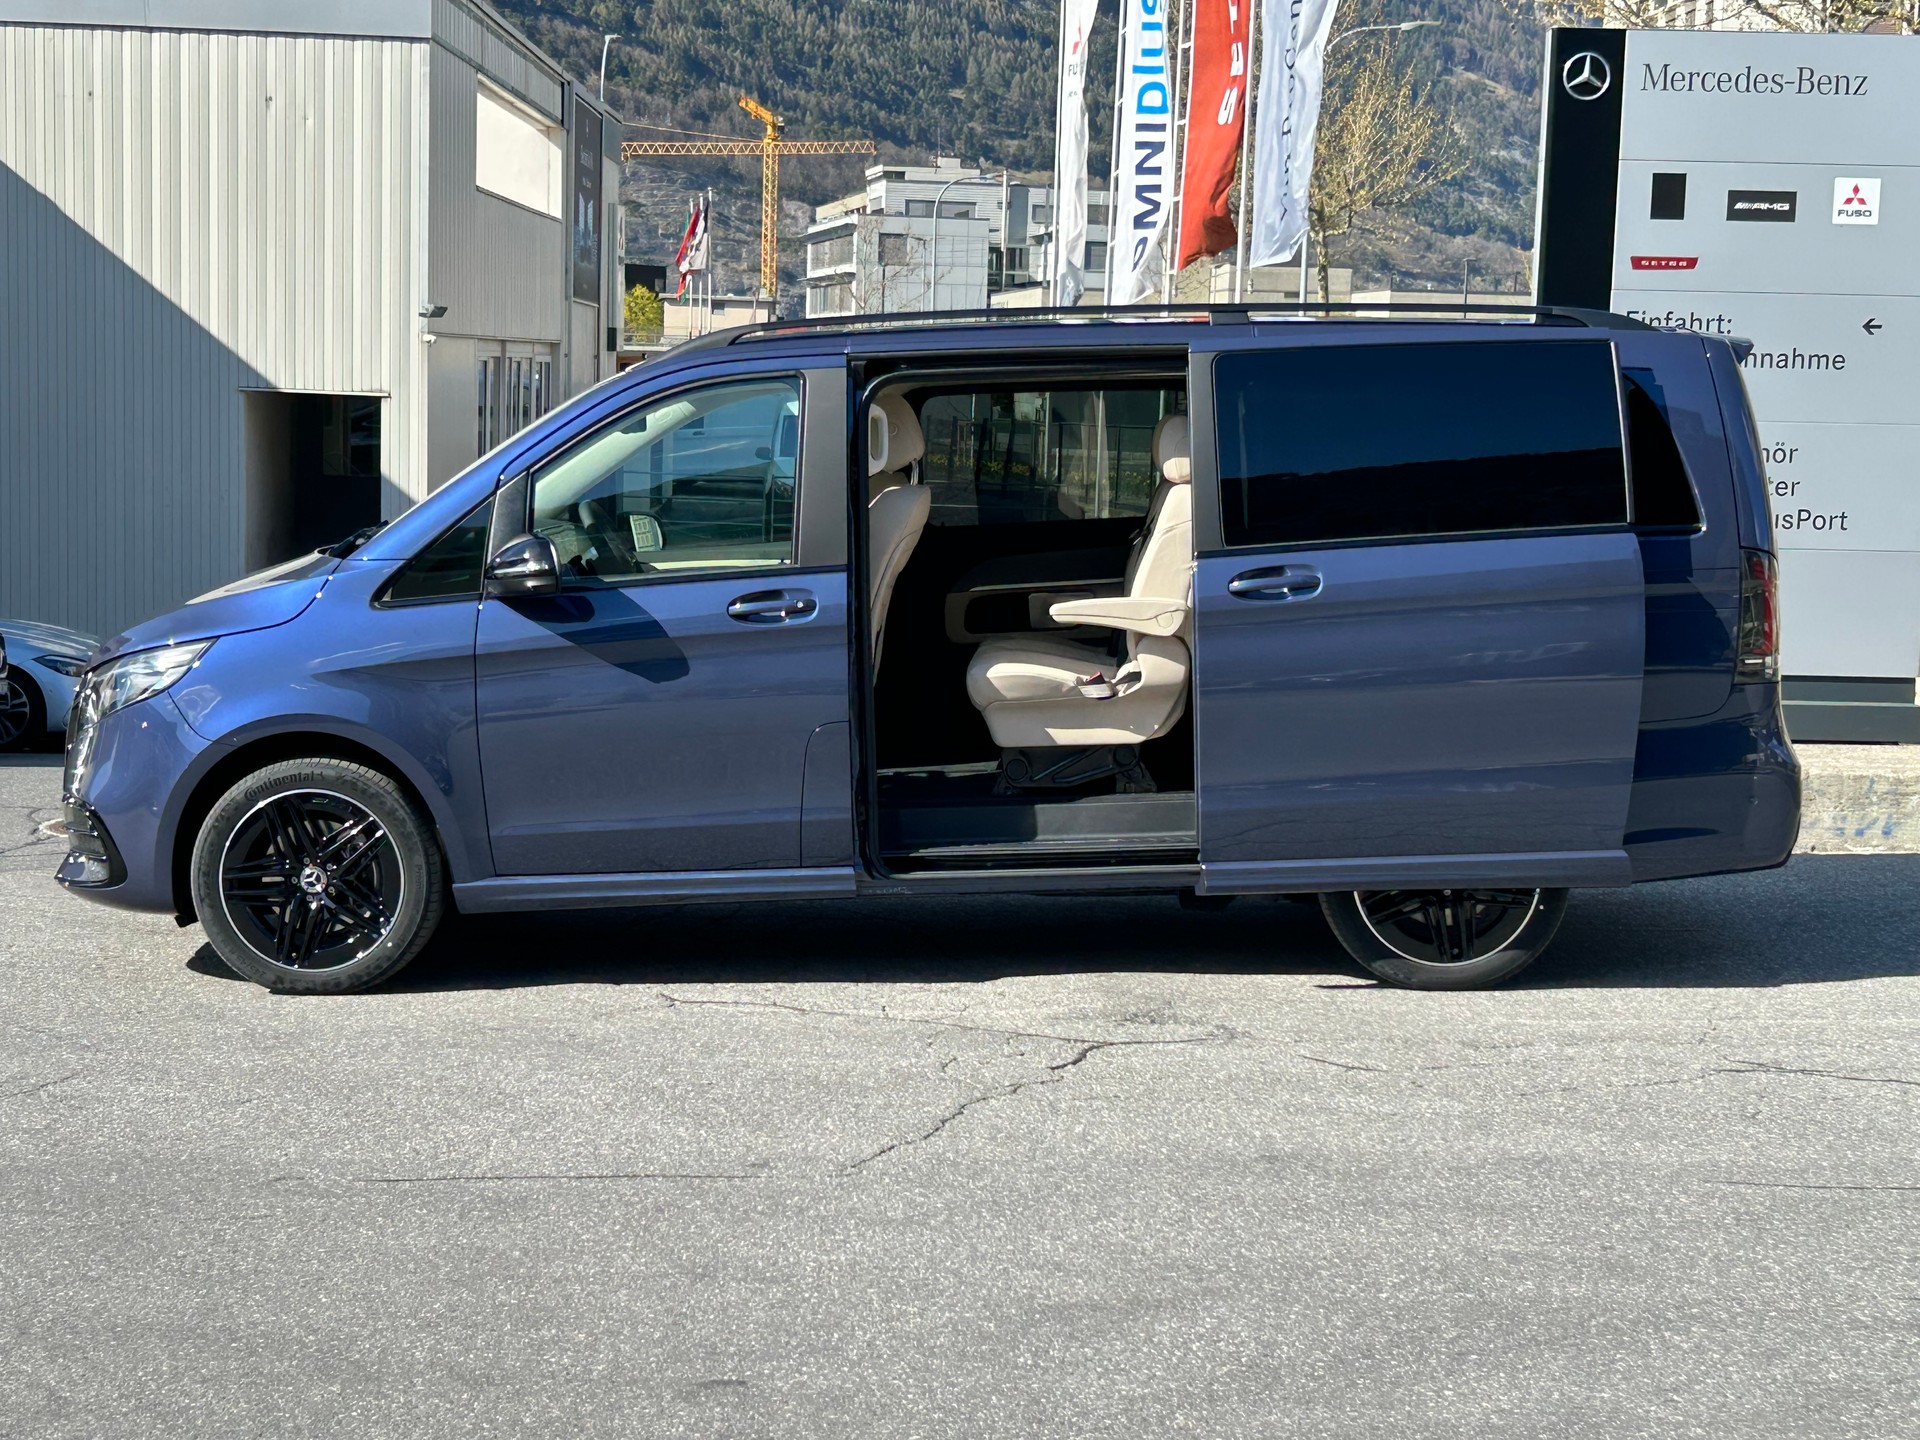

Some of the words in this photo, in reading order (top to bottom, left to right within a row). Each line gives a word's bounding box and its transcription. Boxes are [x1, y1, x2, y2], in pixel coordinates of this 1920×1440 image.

[1641, 63, 1868, 96] Mercedes-Benz
[1750, 202, 1790, 211] AMG
[1837, 209, 1872, 218] FUSO
[1626, 310, 1733, 335] infahrt:
[1740, 347, 1846, 371] nnahme
[243, 770, 316, 800] Continental
